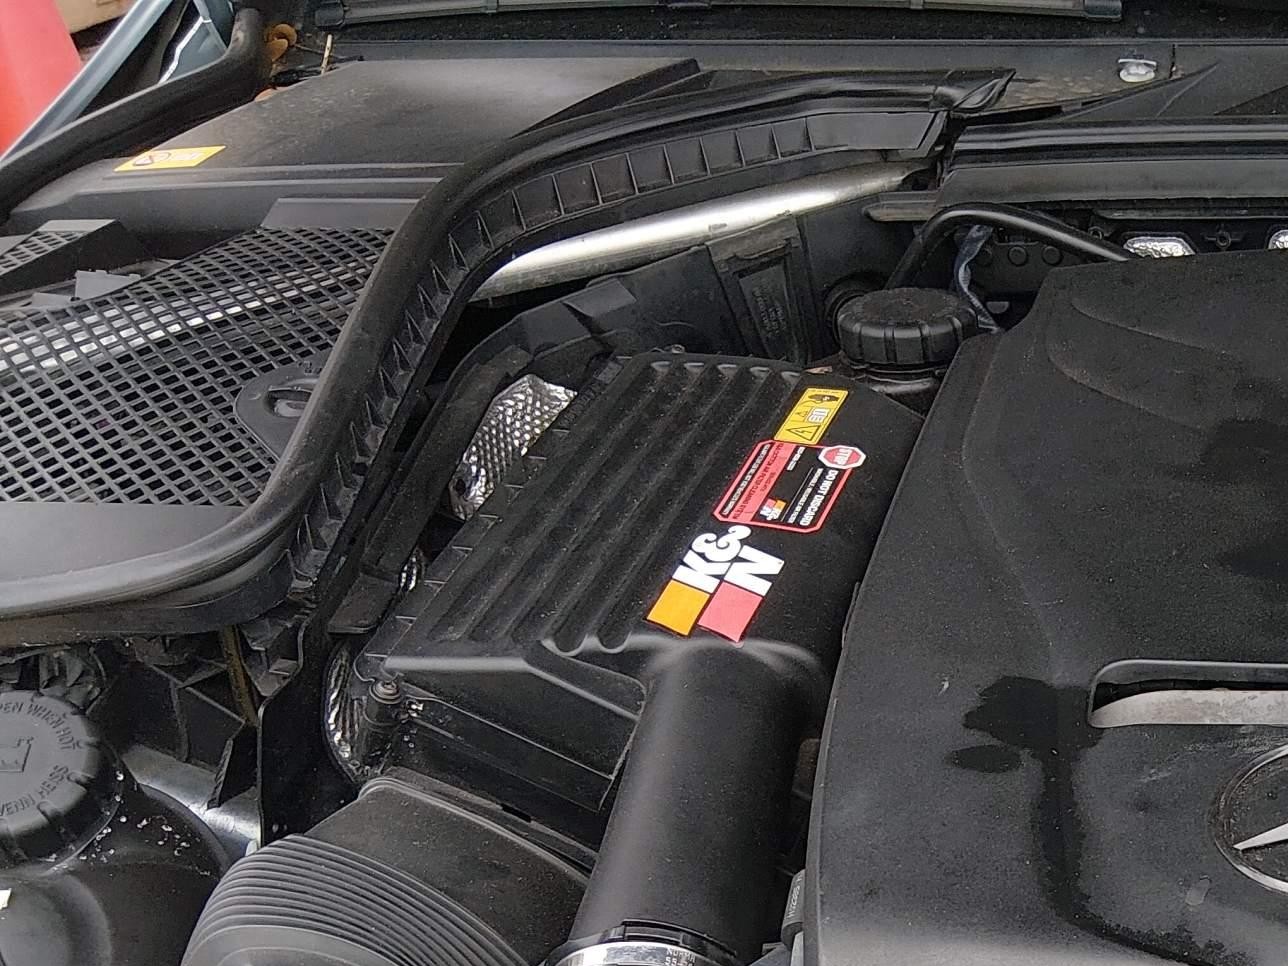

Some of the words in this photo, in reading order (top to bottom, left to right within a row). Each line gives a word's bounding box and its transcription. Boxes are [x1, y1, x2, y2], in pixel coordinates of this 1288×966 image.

[831, 447, 853, 465] STOP
[824, 469, 839, 480] DO
[815, 479, 833, 495] NOT
[797, 494, 825, 526] DISCARD
[672, 525, 784, 597] K&N
[27, 703, 65, 729] WHEN
